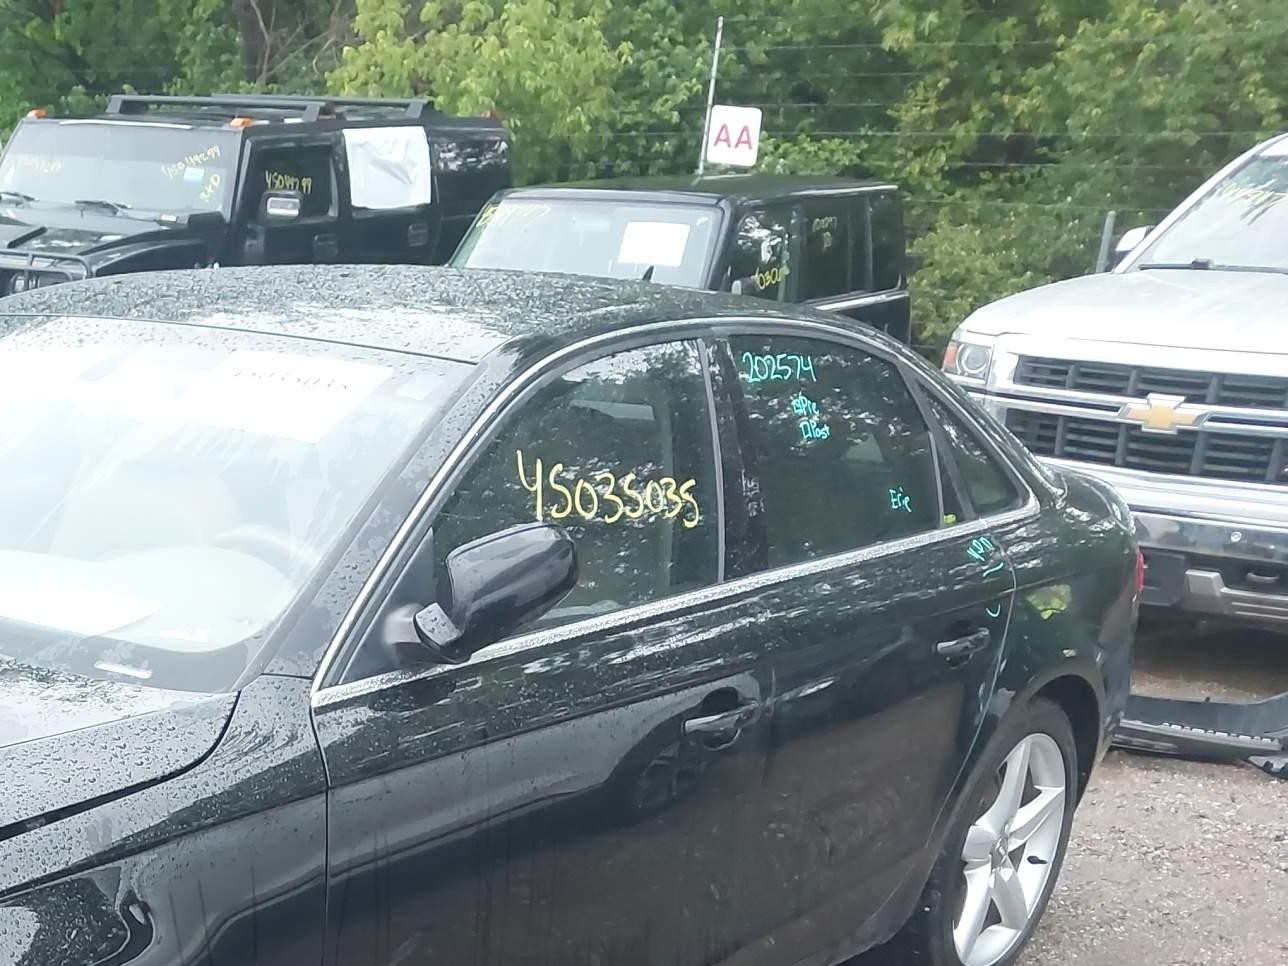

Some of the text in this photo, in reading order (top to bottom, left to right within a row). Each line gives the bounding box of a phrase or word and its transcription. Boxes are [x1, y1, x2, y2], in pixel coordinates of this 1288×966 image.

[713, 123, 753, 150] AA
[742, 352, 817, 383] 202574
[809, 419, 830, 439] Post
[516, 449, 700, 528] 45035035
